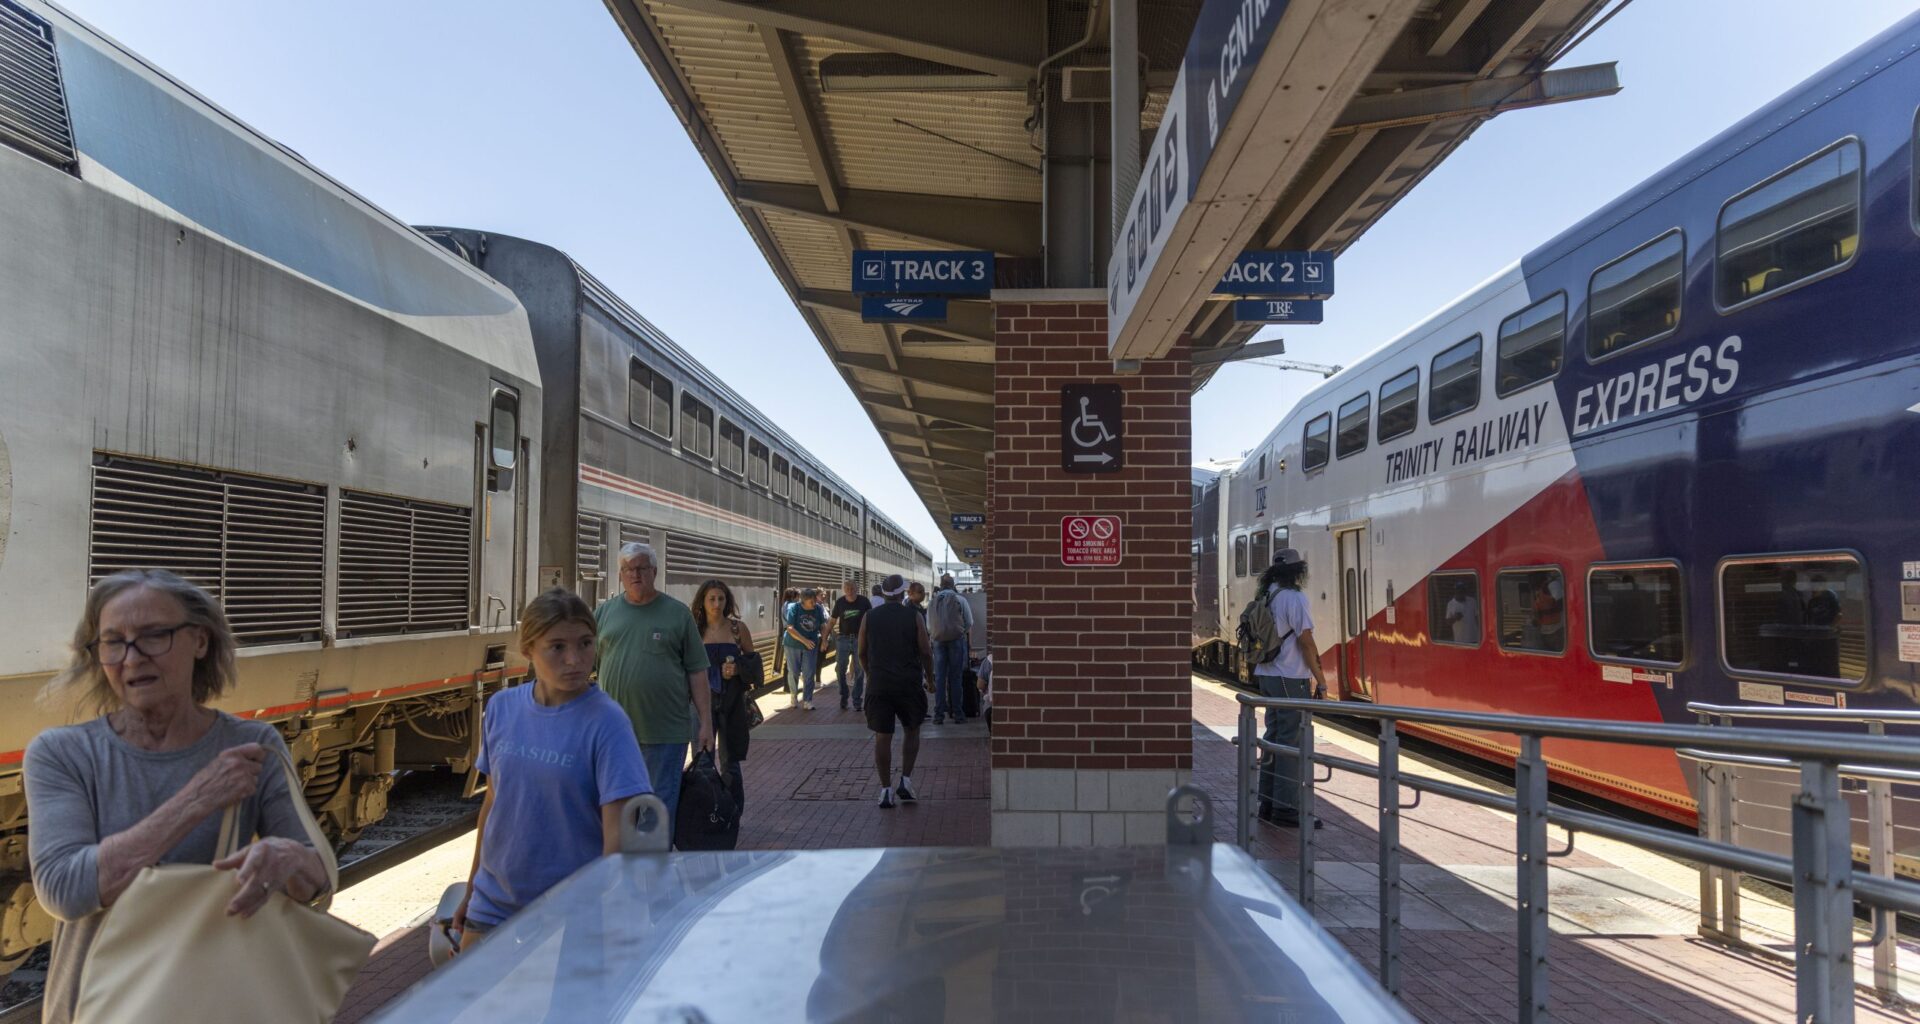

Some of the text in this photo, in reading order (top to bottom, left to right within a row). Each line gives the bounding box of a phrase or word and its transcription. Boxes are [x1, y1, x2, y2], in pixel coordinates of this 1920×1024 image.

[1220, 0, 1270, 98] CENTR
[891, 260, 985, 280] TRACK 3
[1222, 262, 1295, 282] ACK 2
[1266, 301, 1295, 314] TRE
[1386, 335, 1742, 485] TRINITY RAILWAY EXPRESS
[494, 739, 575, 768] SEASIDE
